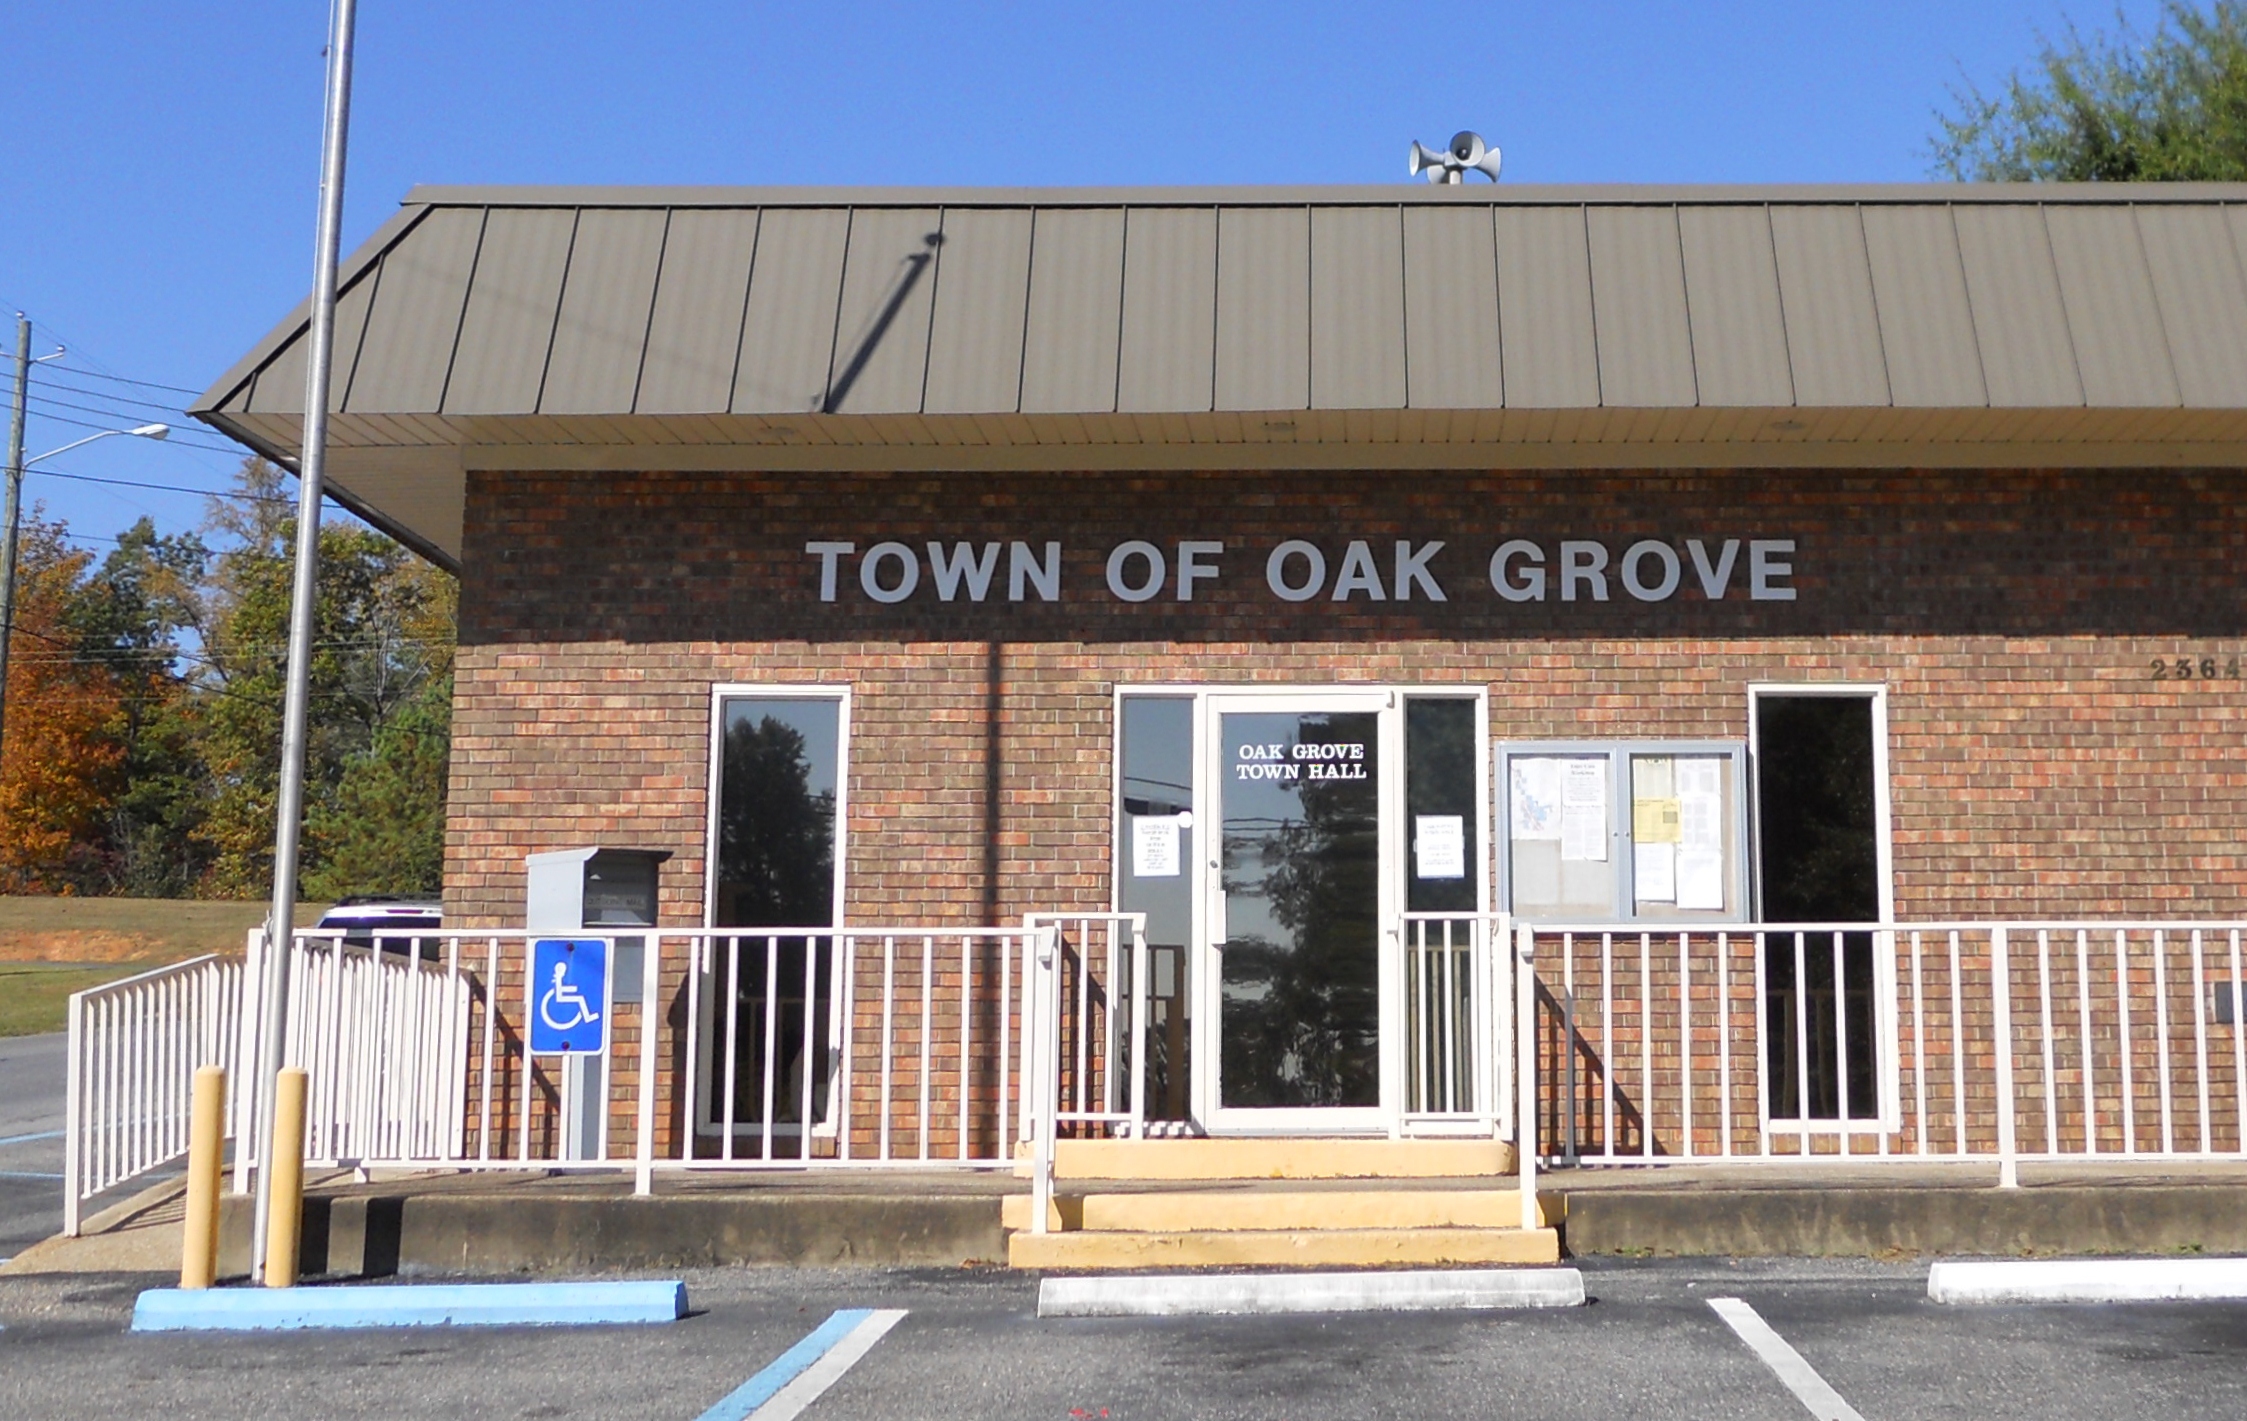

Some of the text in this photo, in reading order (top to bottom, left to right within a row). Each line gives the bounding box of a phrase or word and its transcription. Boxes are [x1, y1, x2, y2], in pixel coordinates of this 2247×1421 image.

[804, 539, 1797, 603] TOWN OF OAK GROVE
[2150, 658, 2240, 680] 2364
[1239, 743, 1364, 760] OAK GROVE
[1236, 763, 1367, 780] TOWN HALL
